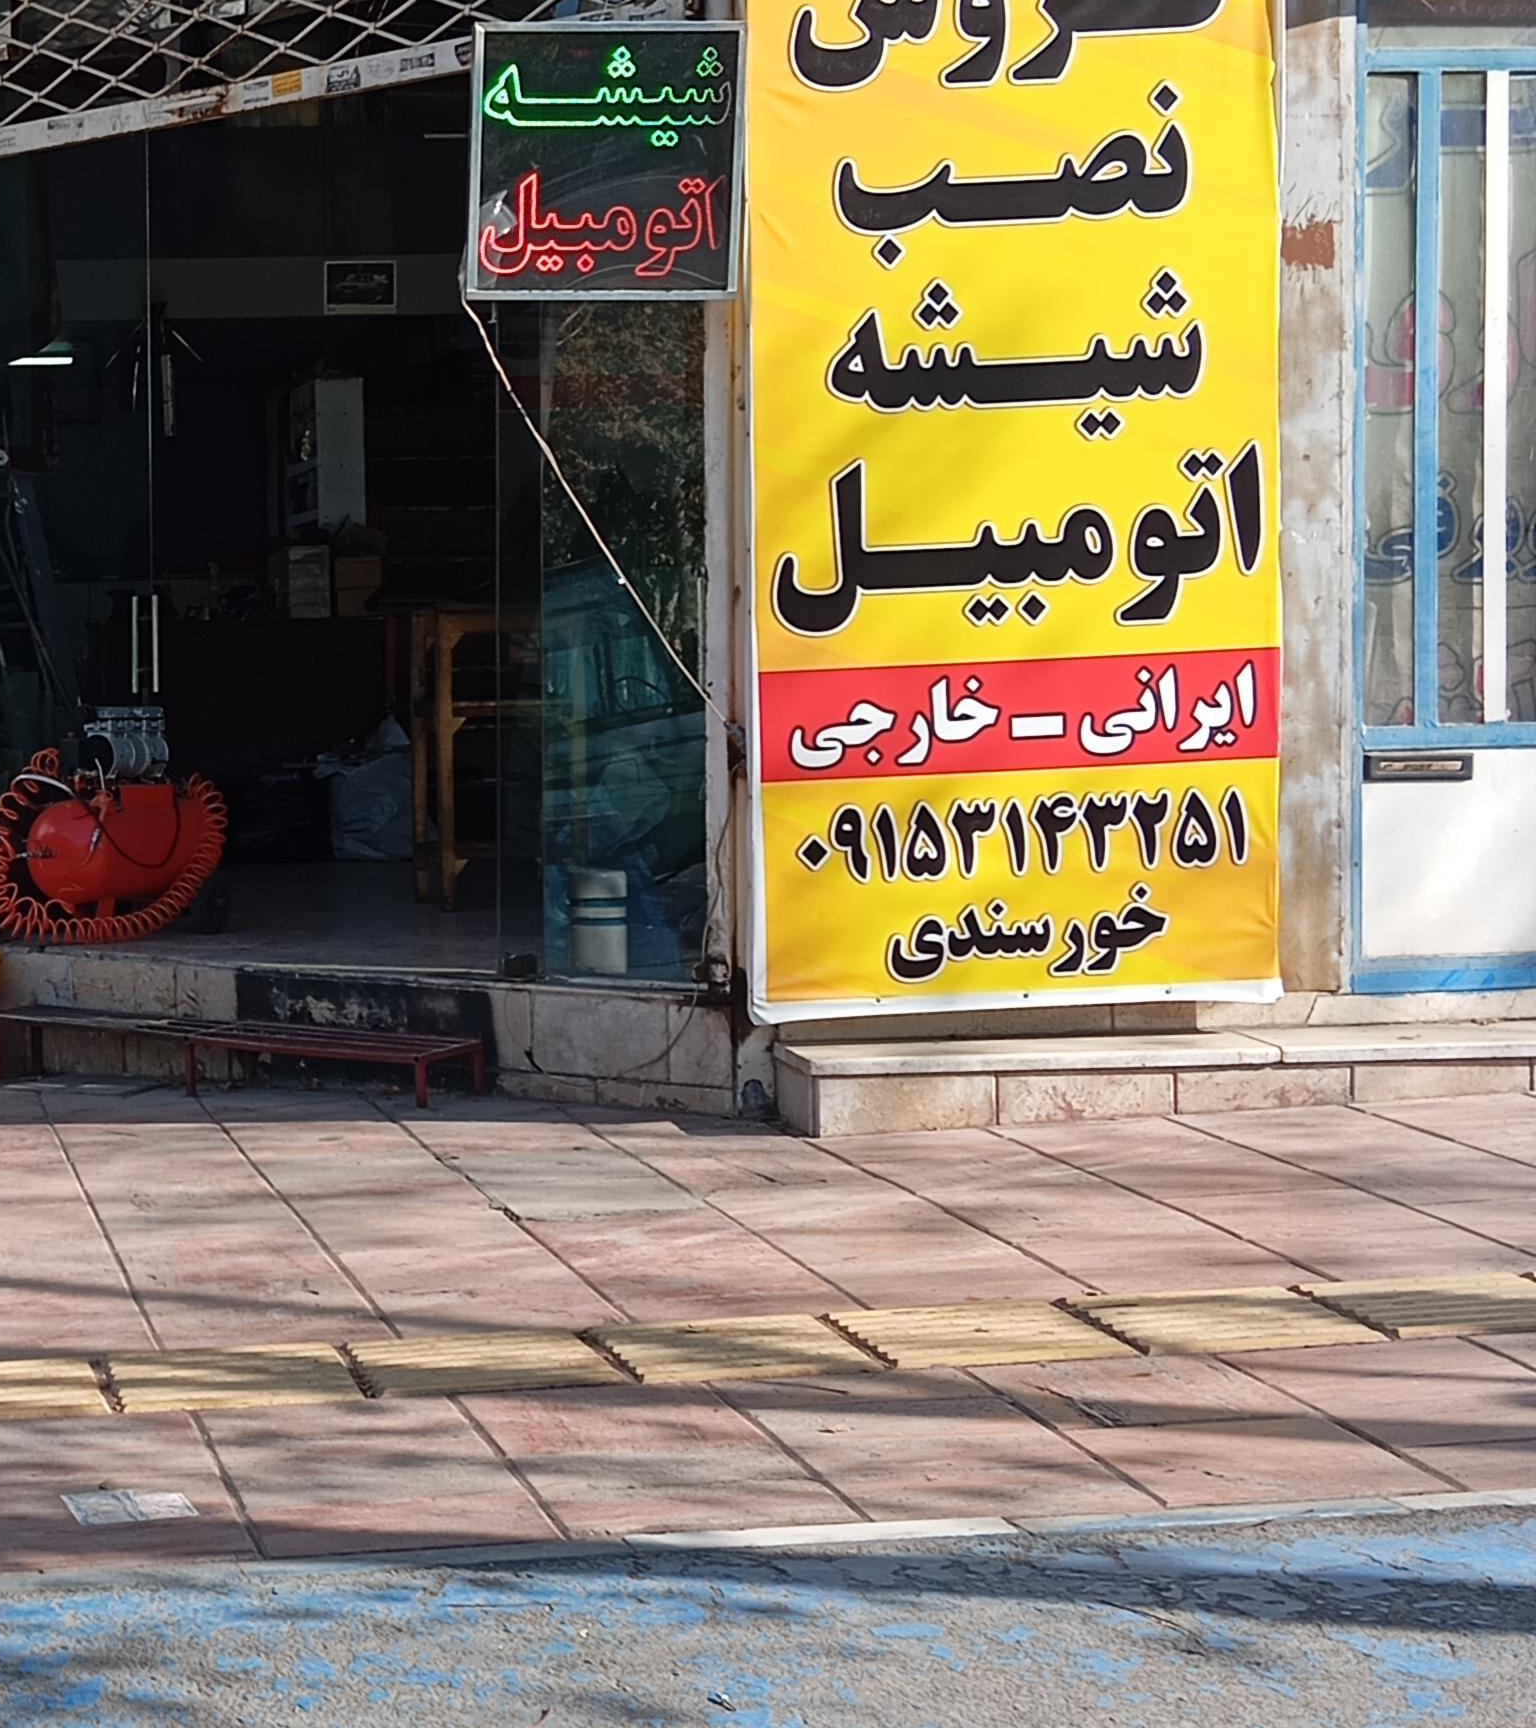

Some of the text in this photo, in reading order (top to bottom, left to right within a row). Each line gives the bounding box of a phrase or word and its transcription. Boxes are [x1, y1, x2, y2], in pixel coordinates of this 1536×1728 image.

[484, 46, 731, 147] شیشه
[479, 172, 727, 277] اتومبیل
[836, 82, 1190, 266] نصب
[828, 270, 1203, 439] شیشه
[774, 441, 1263, 635] اتومبیل
[790, 675, 1001, 770] خارجی
[1078, 660, 1257, 756] ایرانی
[798, 786, 1250, 883] ۰۹۱۵۳۱۴۳۲۵۱
[888, 882, 1167, 980] خورسندی
